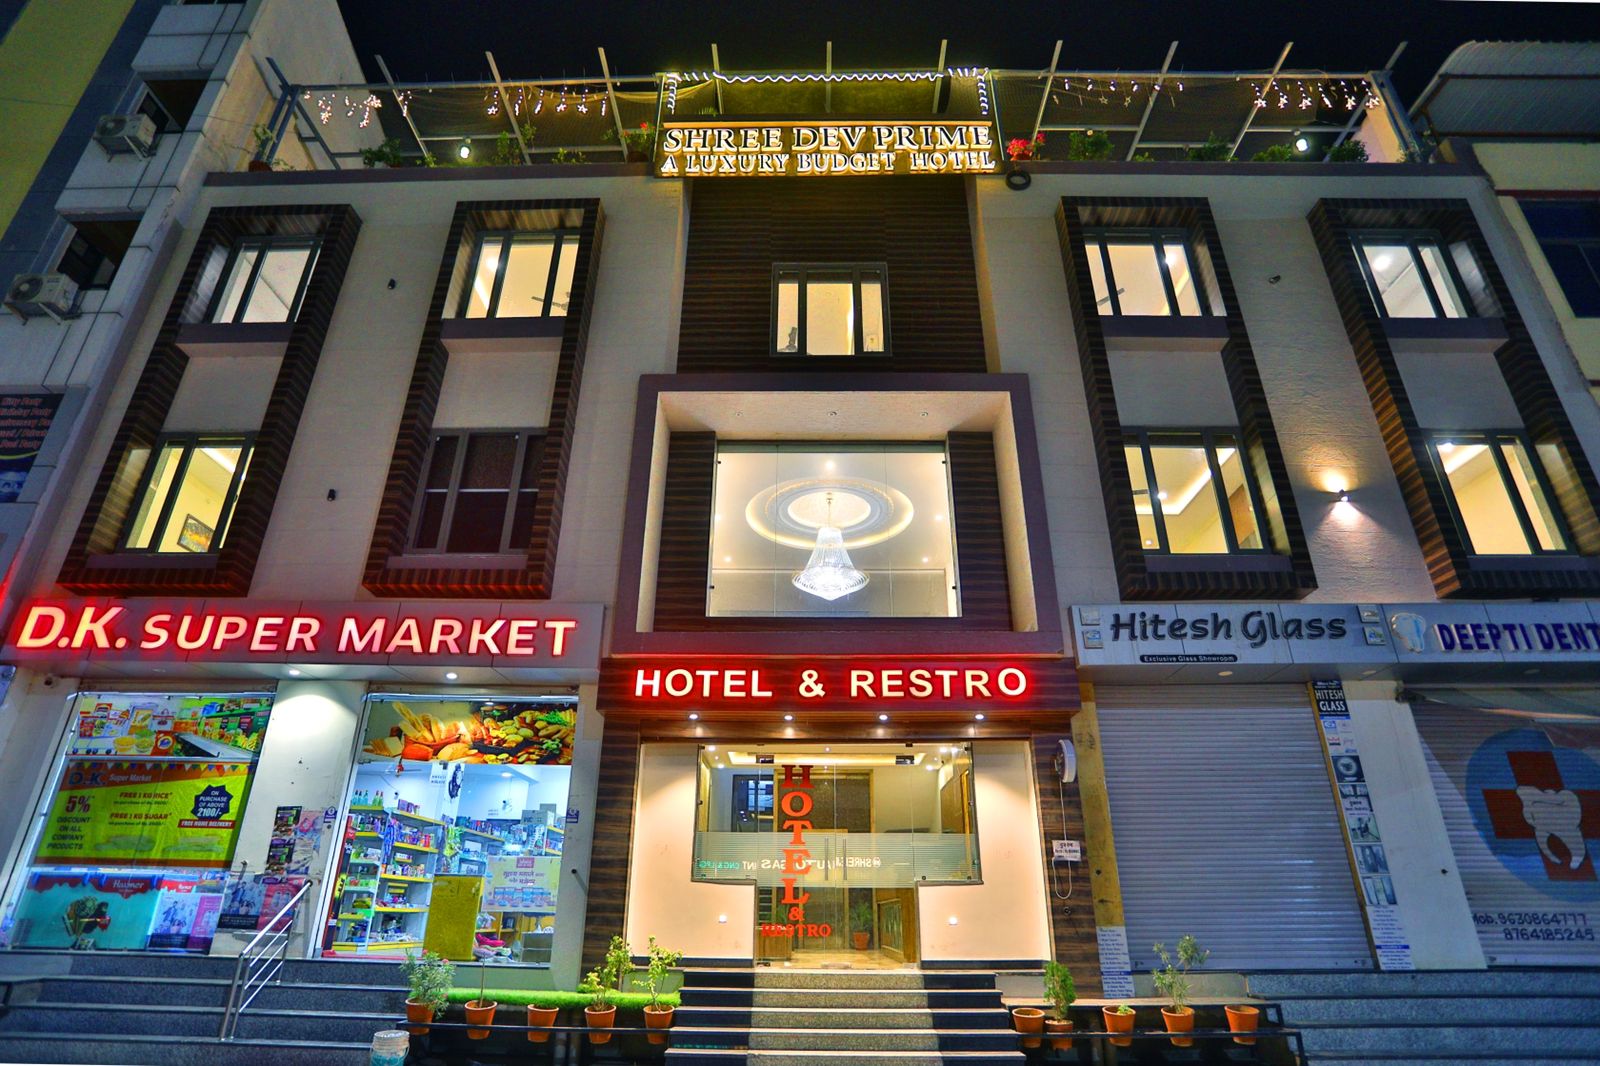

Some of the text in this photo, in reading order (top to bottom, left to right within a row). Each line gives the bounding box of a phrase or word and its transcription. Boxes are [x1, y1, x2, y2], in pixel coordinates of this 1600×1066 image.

[664, 126, 993, 152] SHREE DEV PRIME
[661, 151, 995, 173] A LUXURY BUDGET HOTEL
[16, 606, 579, 656] D.K. SUPER MARKET
[1110, 609, 1348, 649] Hitesh Glass
[1433, 623, 1533, 650] DEEPTI
[1143, 655, 1177, 663] Exclusive
[635, 667, 1028, 698] HOTEL & RESTRO
[1314, 689, 1345, 700] HITESH
[1319, 701, 1346, 711] GLASS
[781, 764, 815, 904] HOTEL
[788, 906, 805, 921] &
